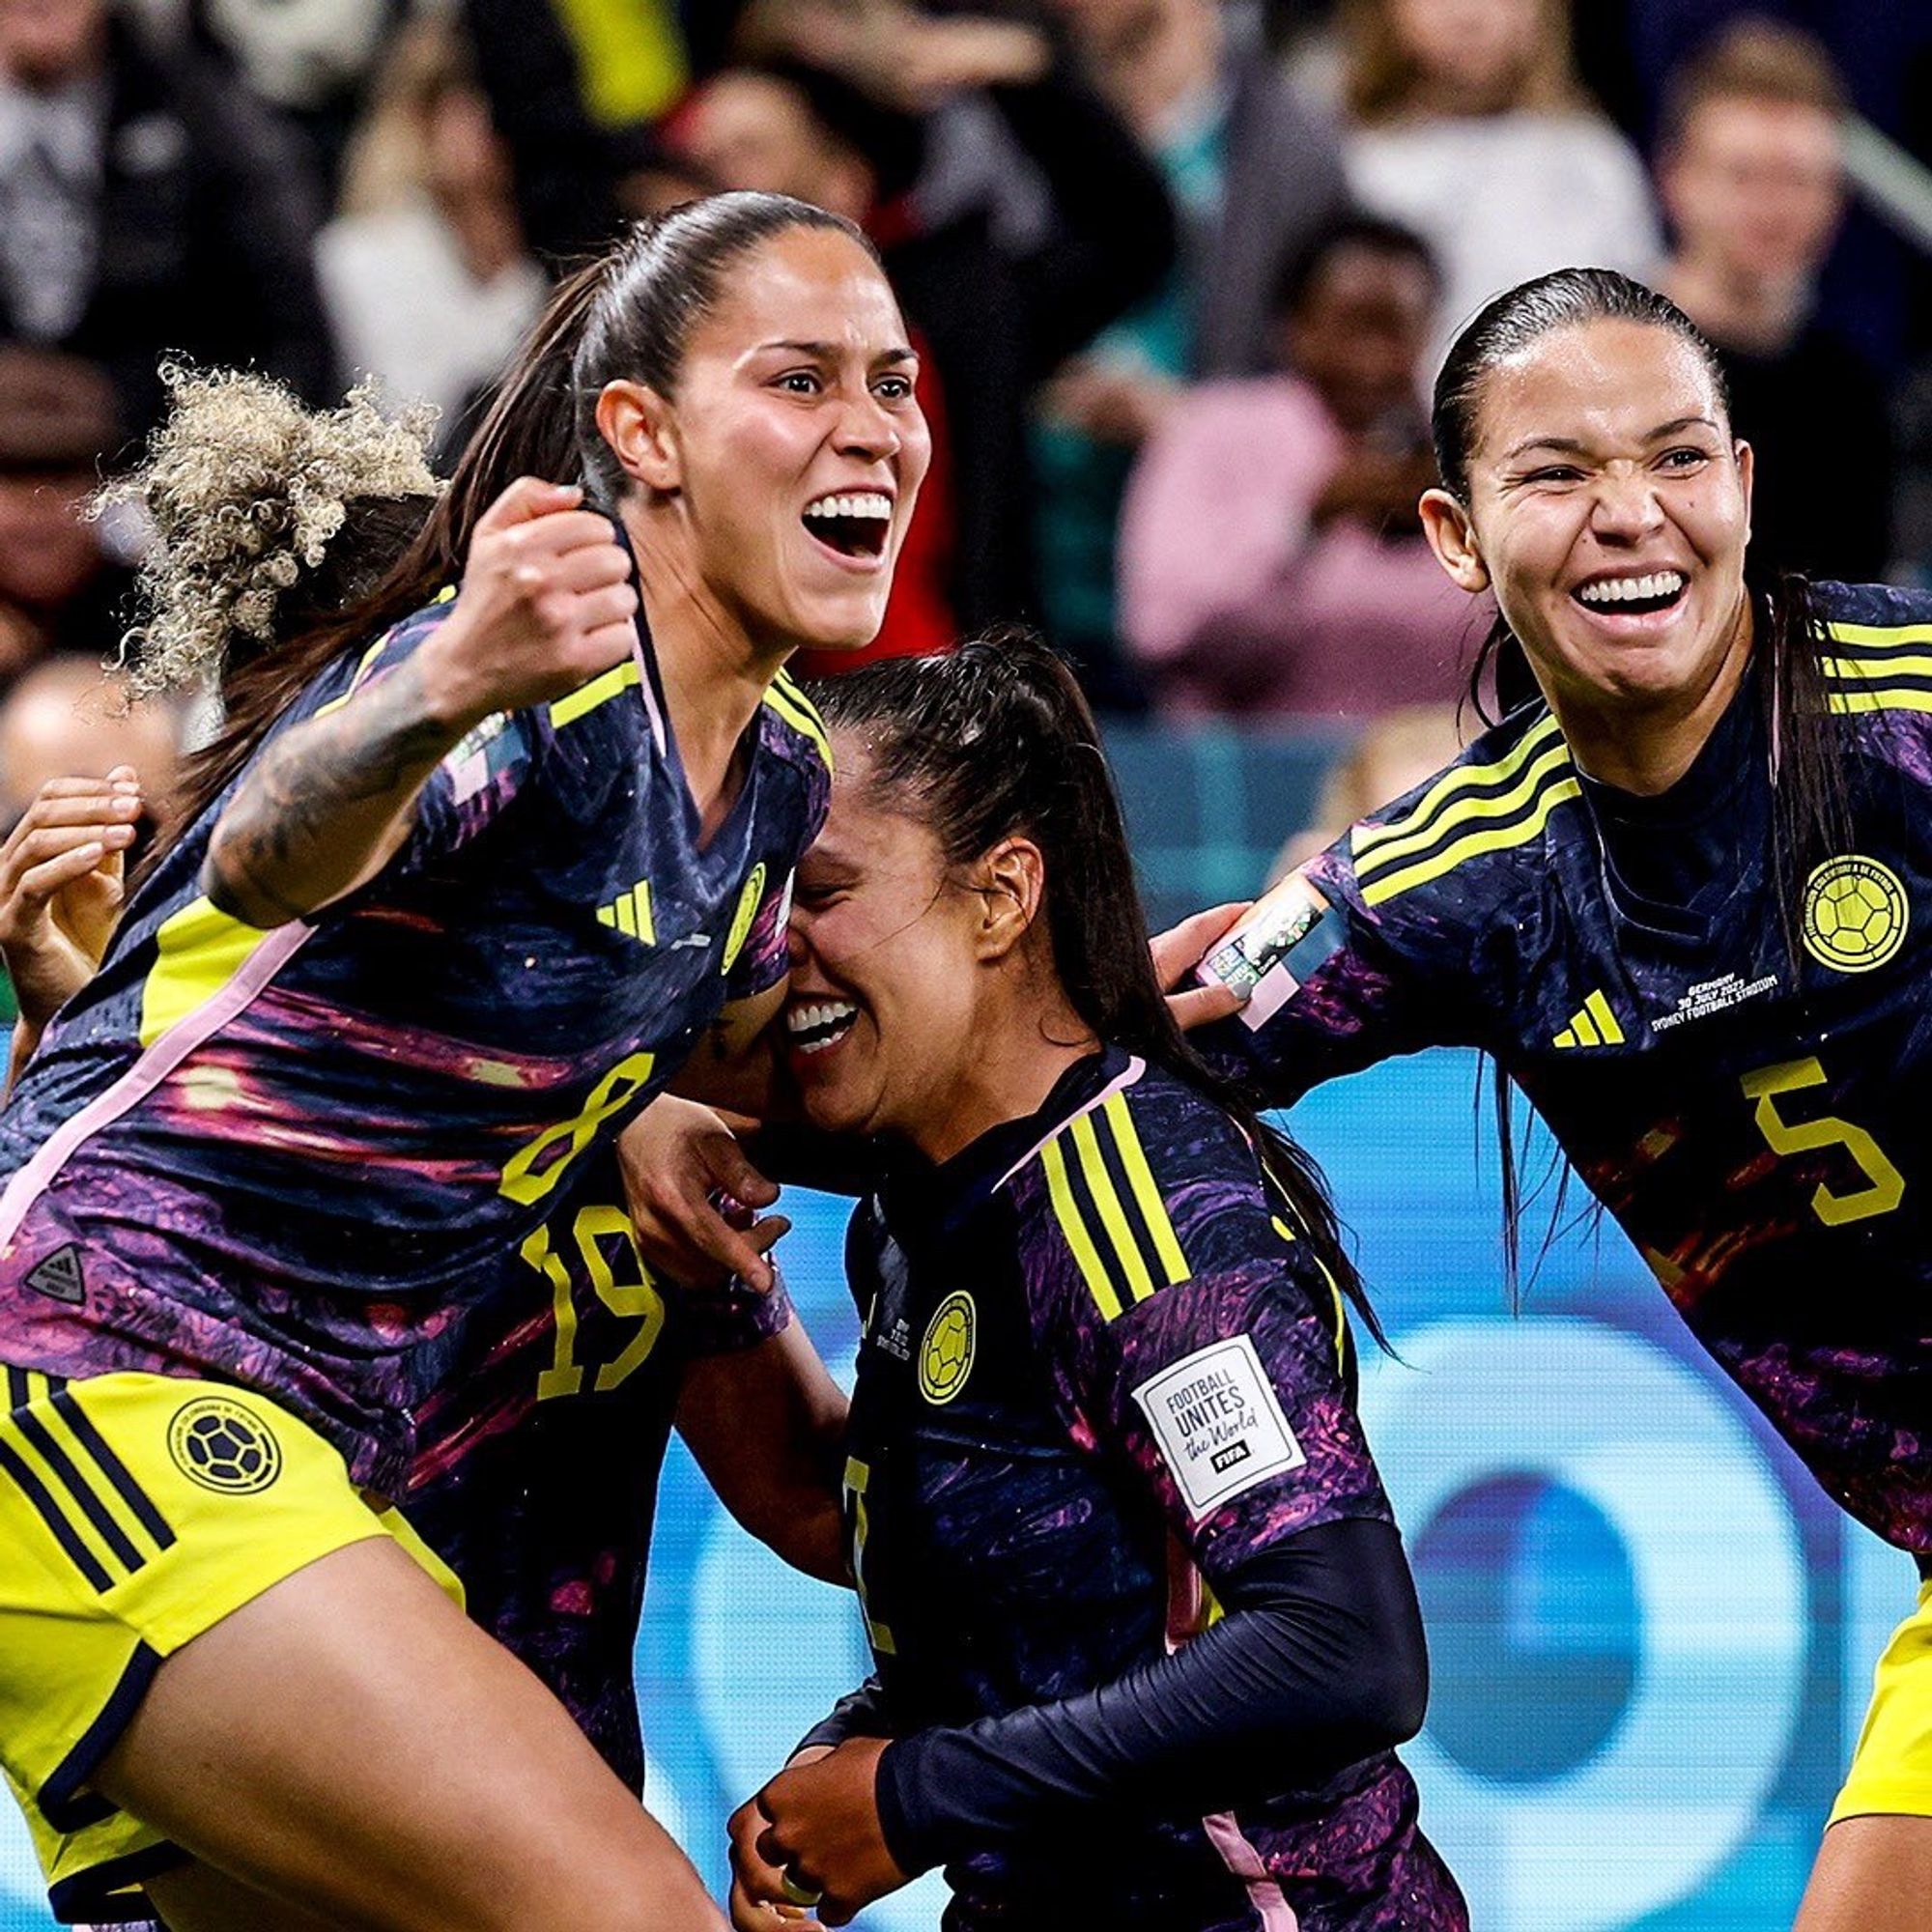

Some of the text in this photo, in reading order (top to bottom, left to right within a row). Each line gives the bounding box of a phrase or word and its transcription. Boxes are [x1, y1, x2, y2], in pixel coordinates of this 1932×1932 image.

[1651, 974, 1778, 1032] SYDNEY FOOTBALL STADIUM
[1677, 979, 1745, 1010] 30 JULY 2023
[497, 1052, 655, 1206] 8
[1740, 1056, 1906, 1227] 5
[521, 1206, 665, 1401] 19
[1166, 1368, 1236, 1414] FOOTBALL
[1175, 1386, 1245, 1437] UNITES
[1184, 1407, 1259, 1462] the World
[1213, 1443, 1248, 1470] FIFA
